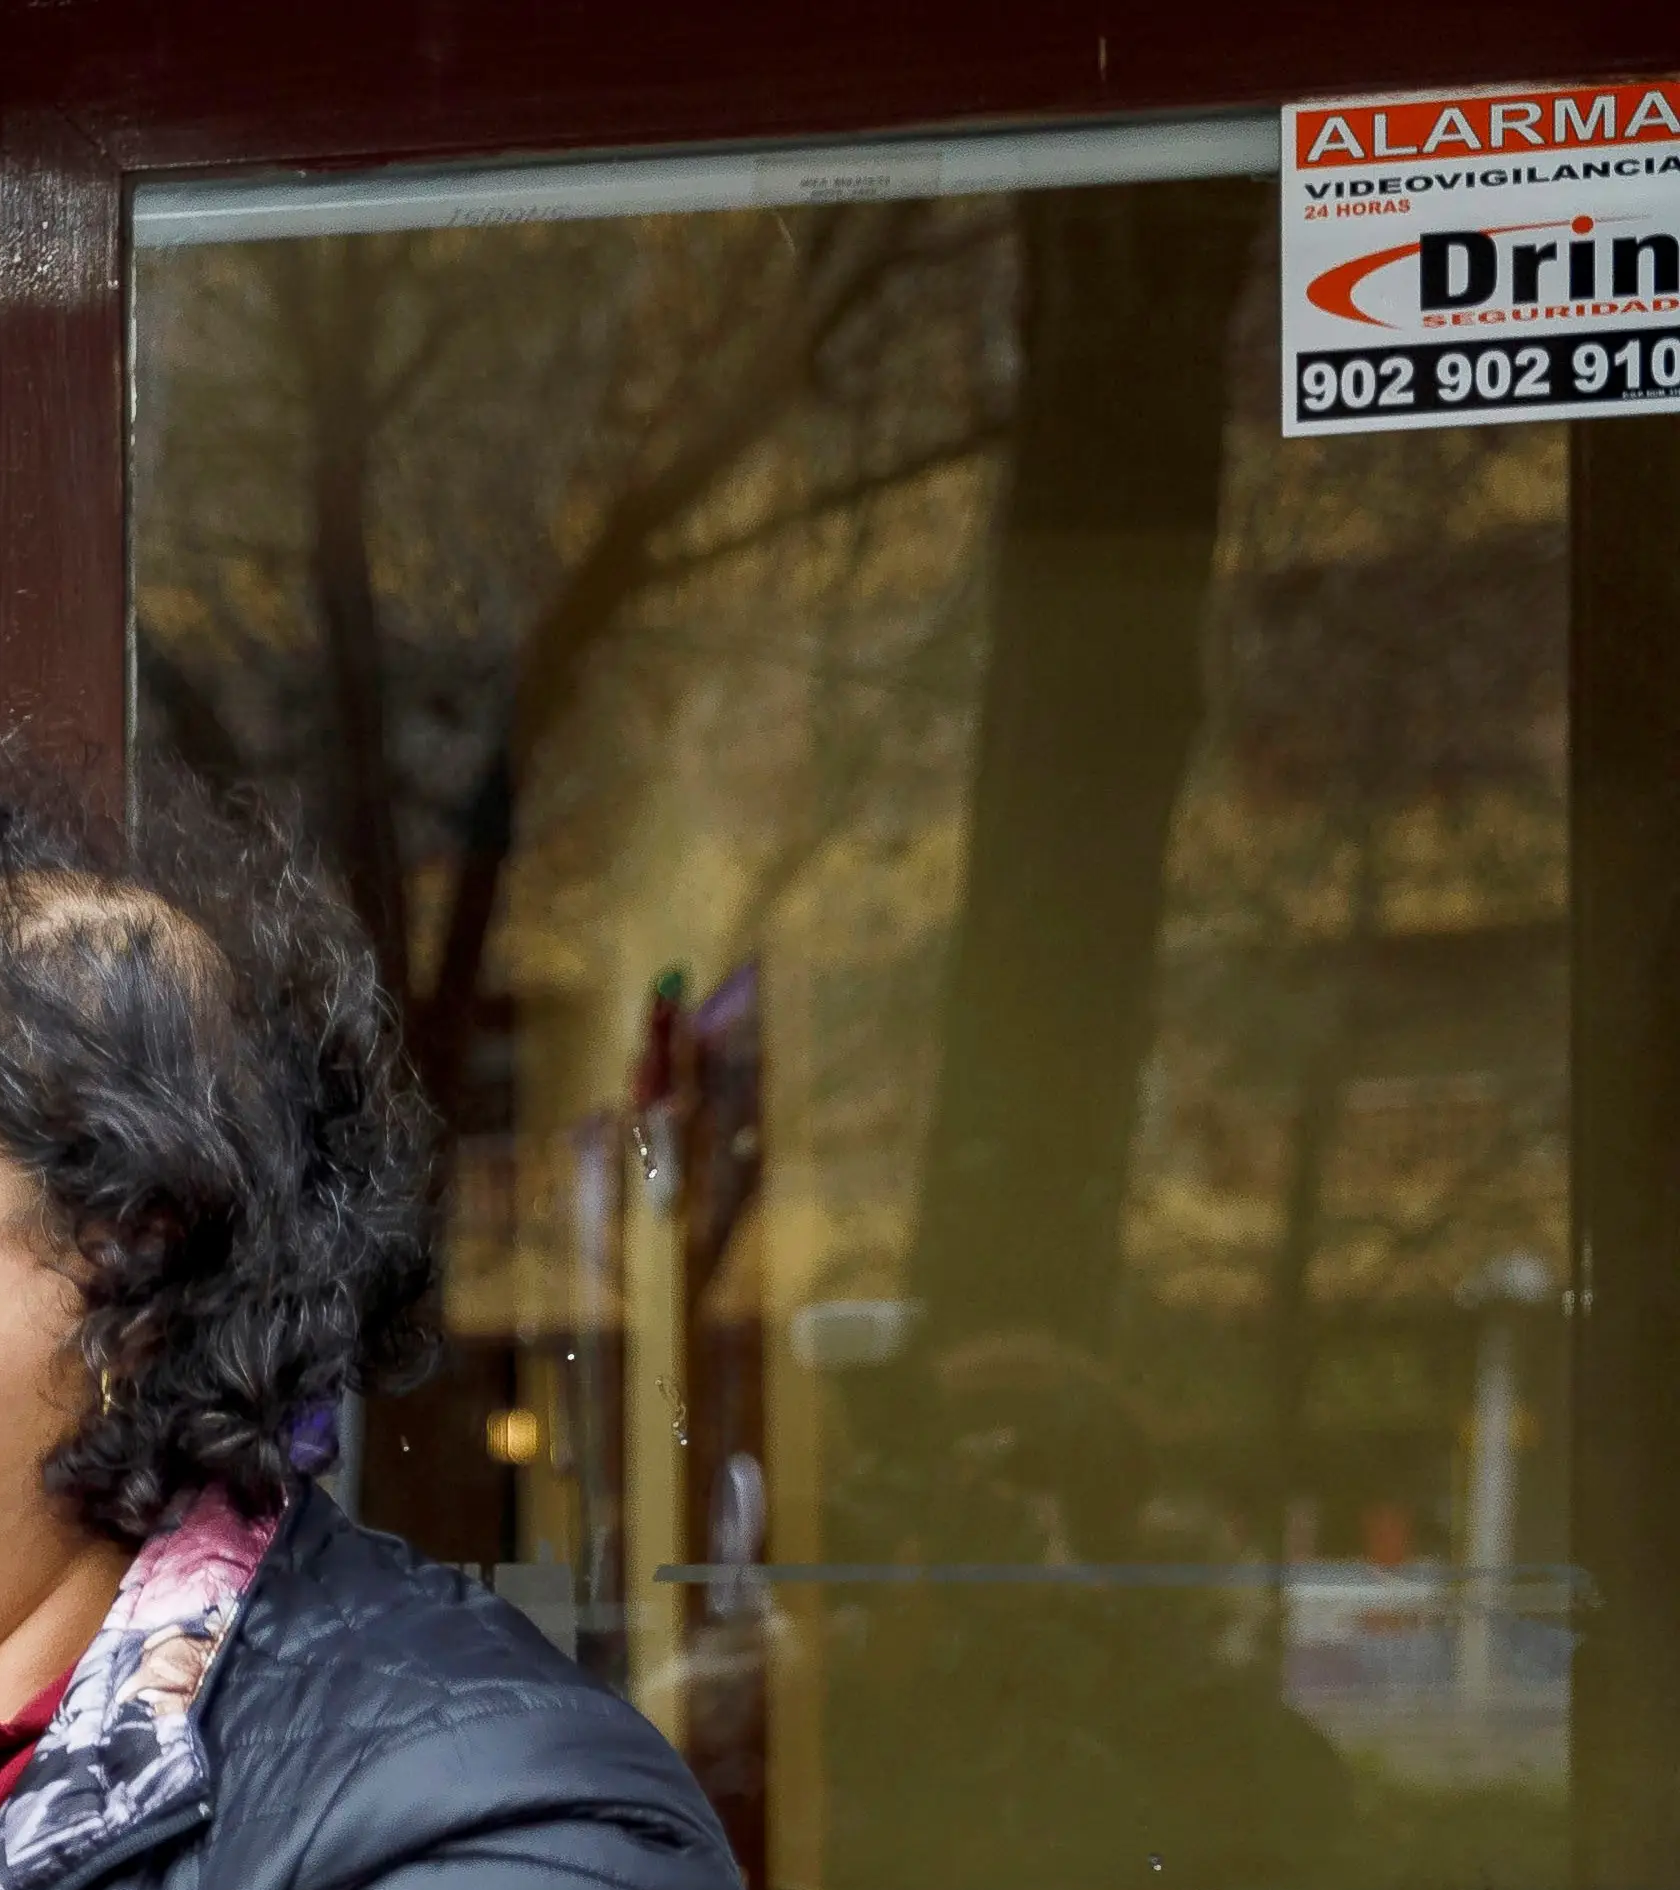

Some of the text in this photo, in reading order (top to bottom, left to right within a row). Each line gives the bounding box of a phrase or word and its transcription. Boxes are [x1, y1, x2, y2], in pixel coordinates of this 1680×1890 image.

[1306, 89, 1680, 164] ALARMA
[1304, 155, 1680, 200] VIDEOVIGILANCIA
[1303, 200, 1411, 221] 24 HORAS
[1420, 214, 1679, 312] Drin
[1422, 296, 1680, 329] SEGURIDAD
[1302, 337, 1680, 413] 902 902 910
